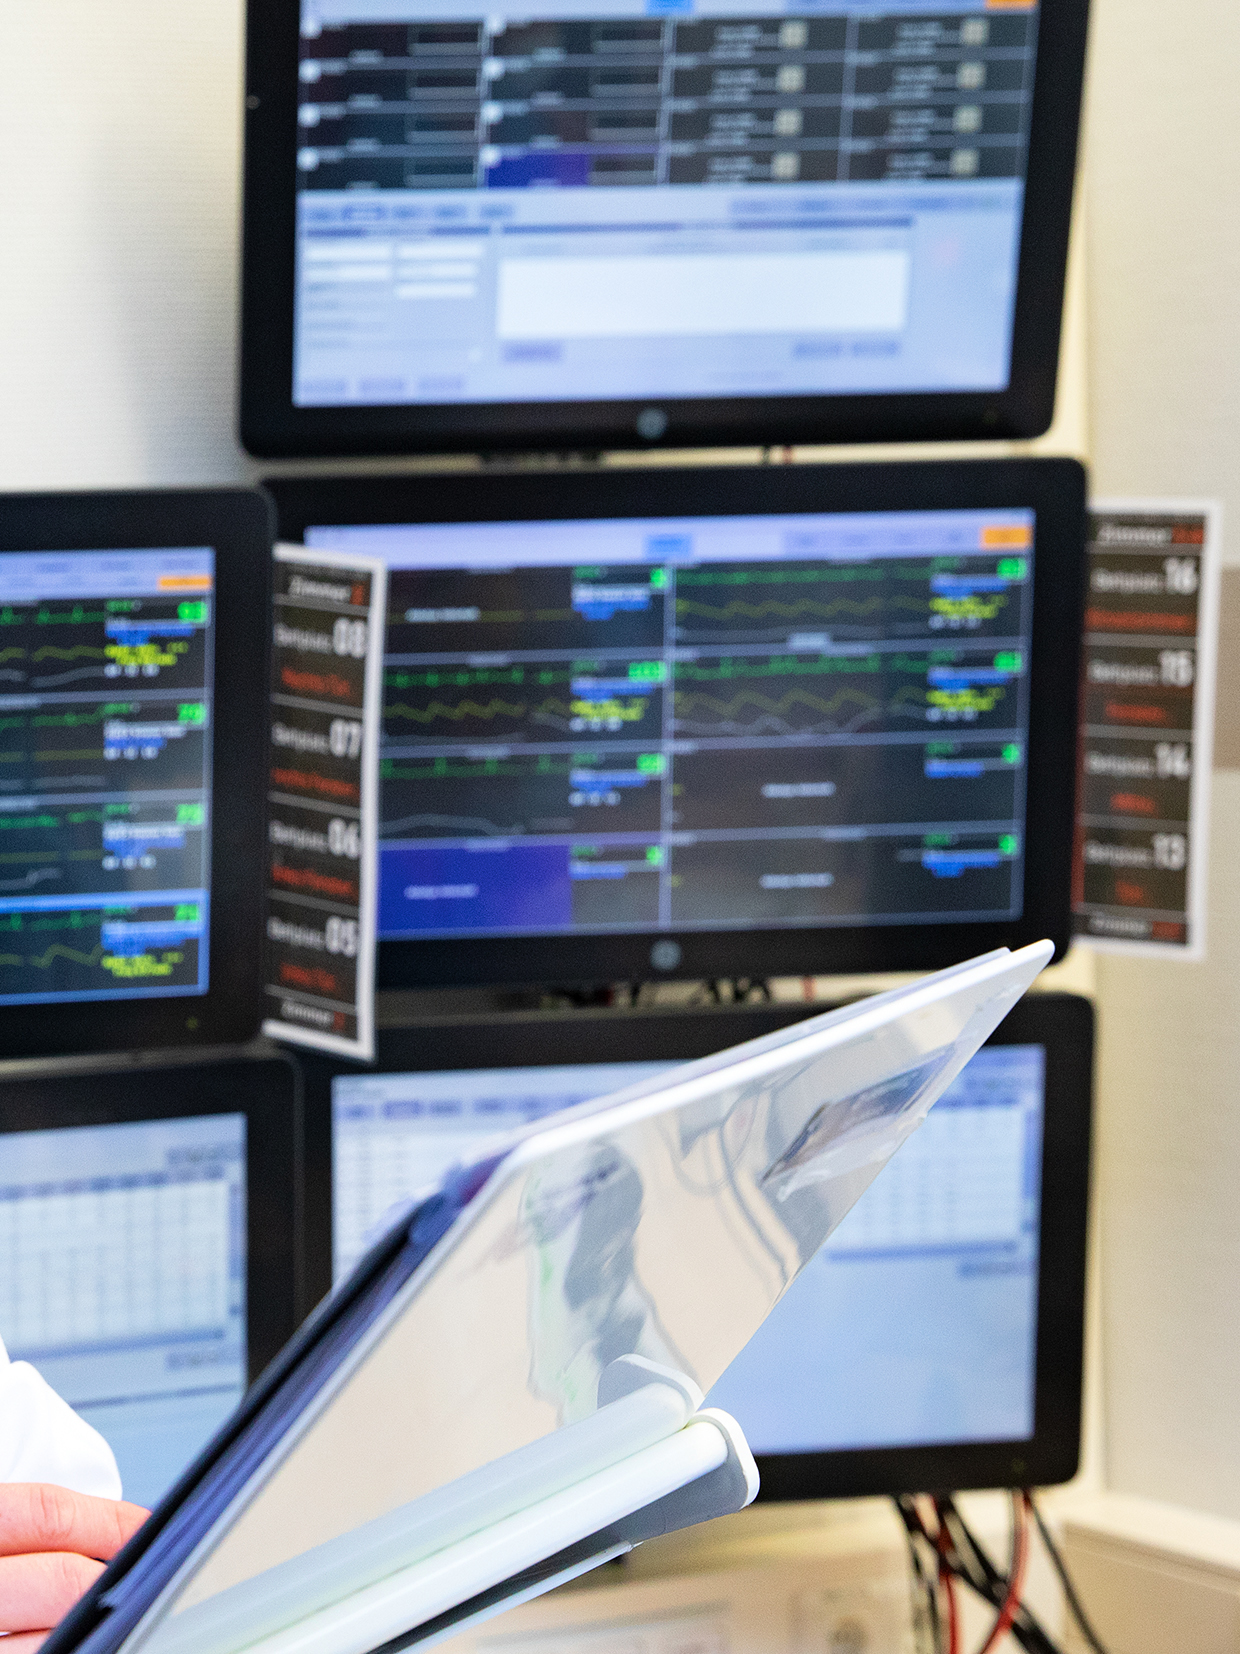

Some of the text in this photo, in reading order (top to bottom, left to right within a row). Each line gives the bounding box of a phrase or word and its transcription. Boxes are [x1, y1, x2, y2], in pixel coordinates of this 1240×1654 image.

[1165, 557, 1198, 595] 16
[333, 618, 367, 658] 08
[1158, 651, 1193, 687] 15
[331, 719, 361, 759] 07
[1155, 742, 1191, 778] 14
[328, 817, 360, 859] 06
[1153, 833, 1186, 871] 13
[325, 916, 358, 957] 05
